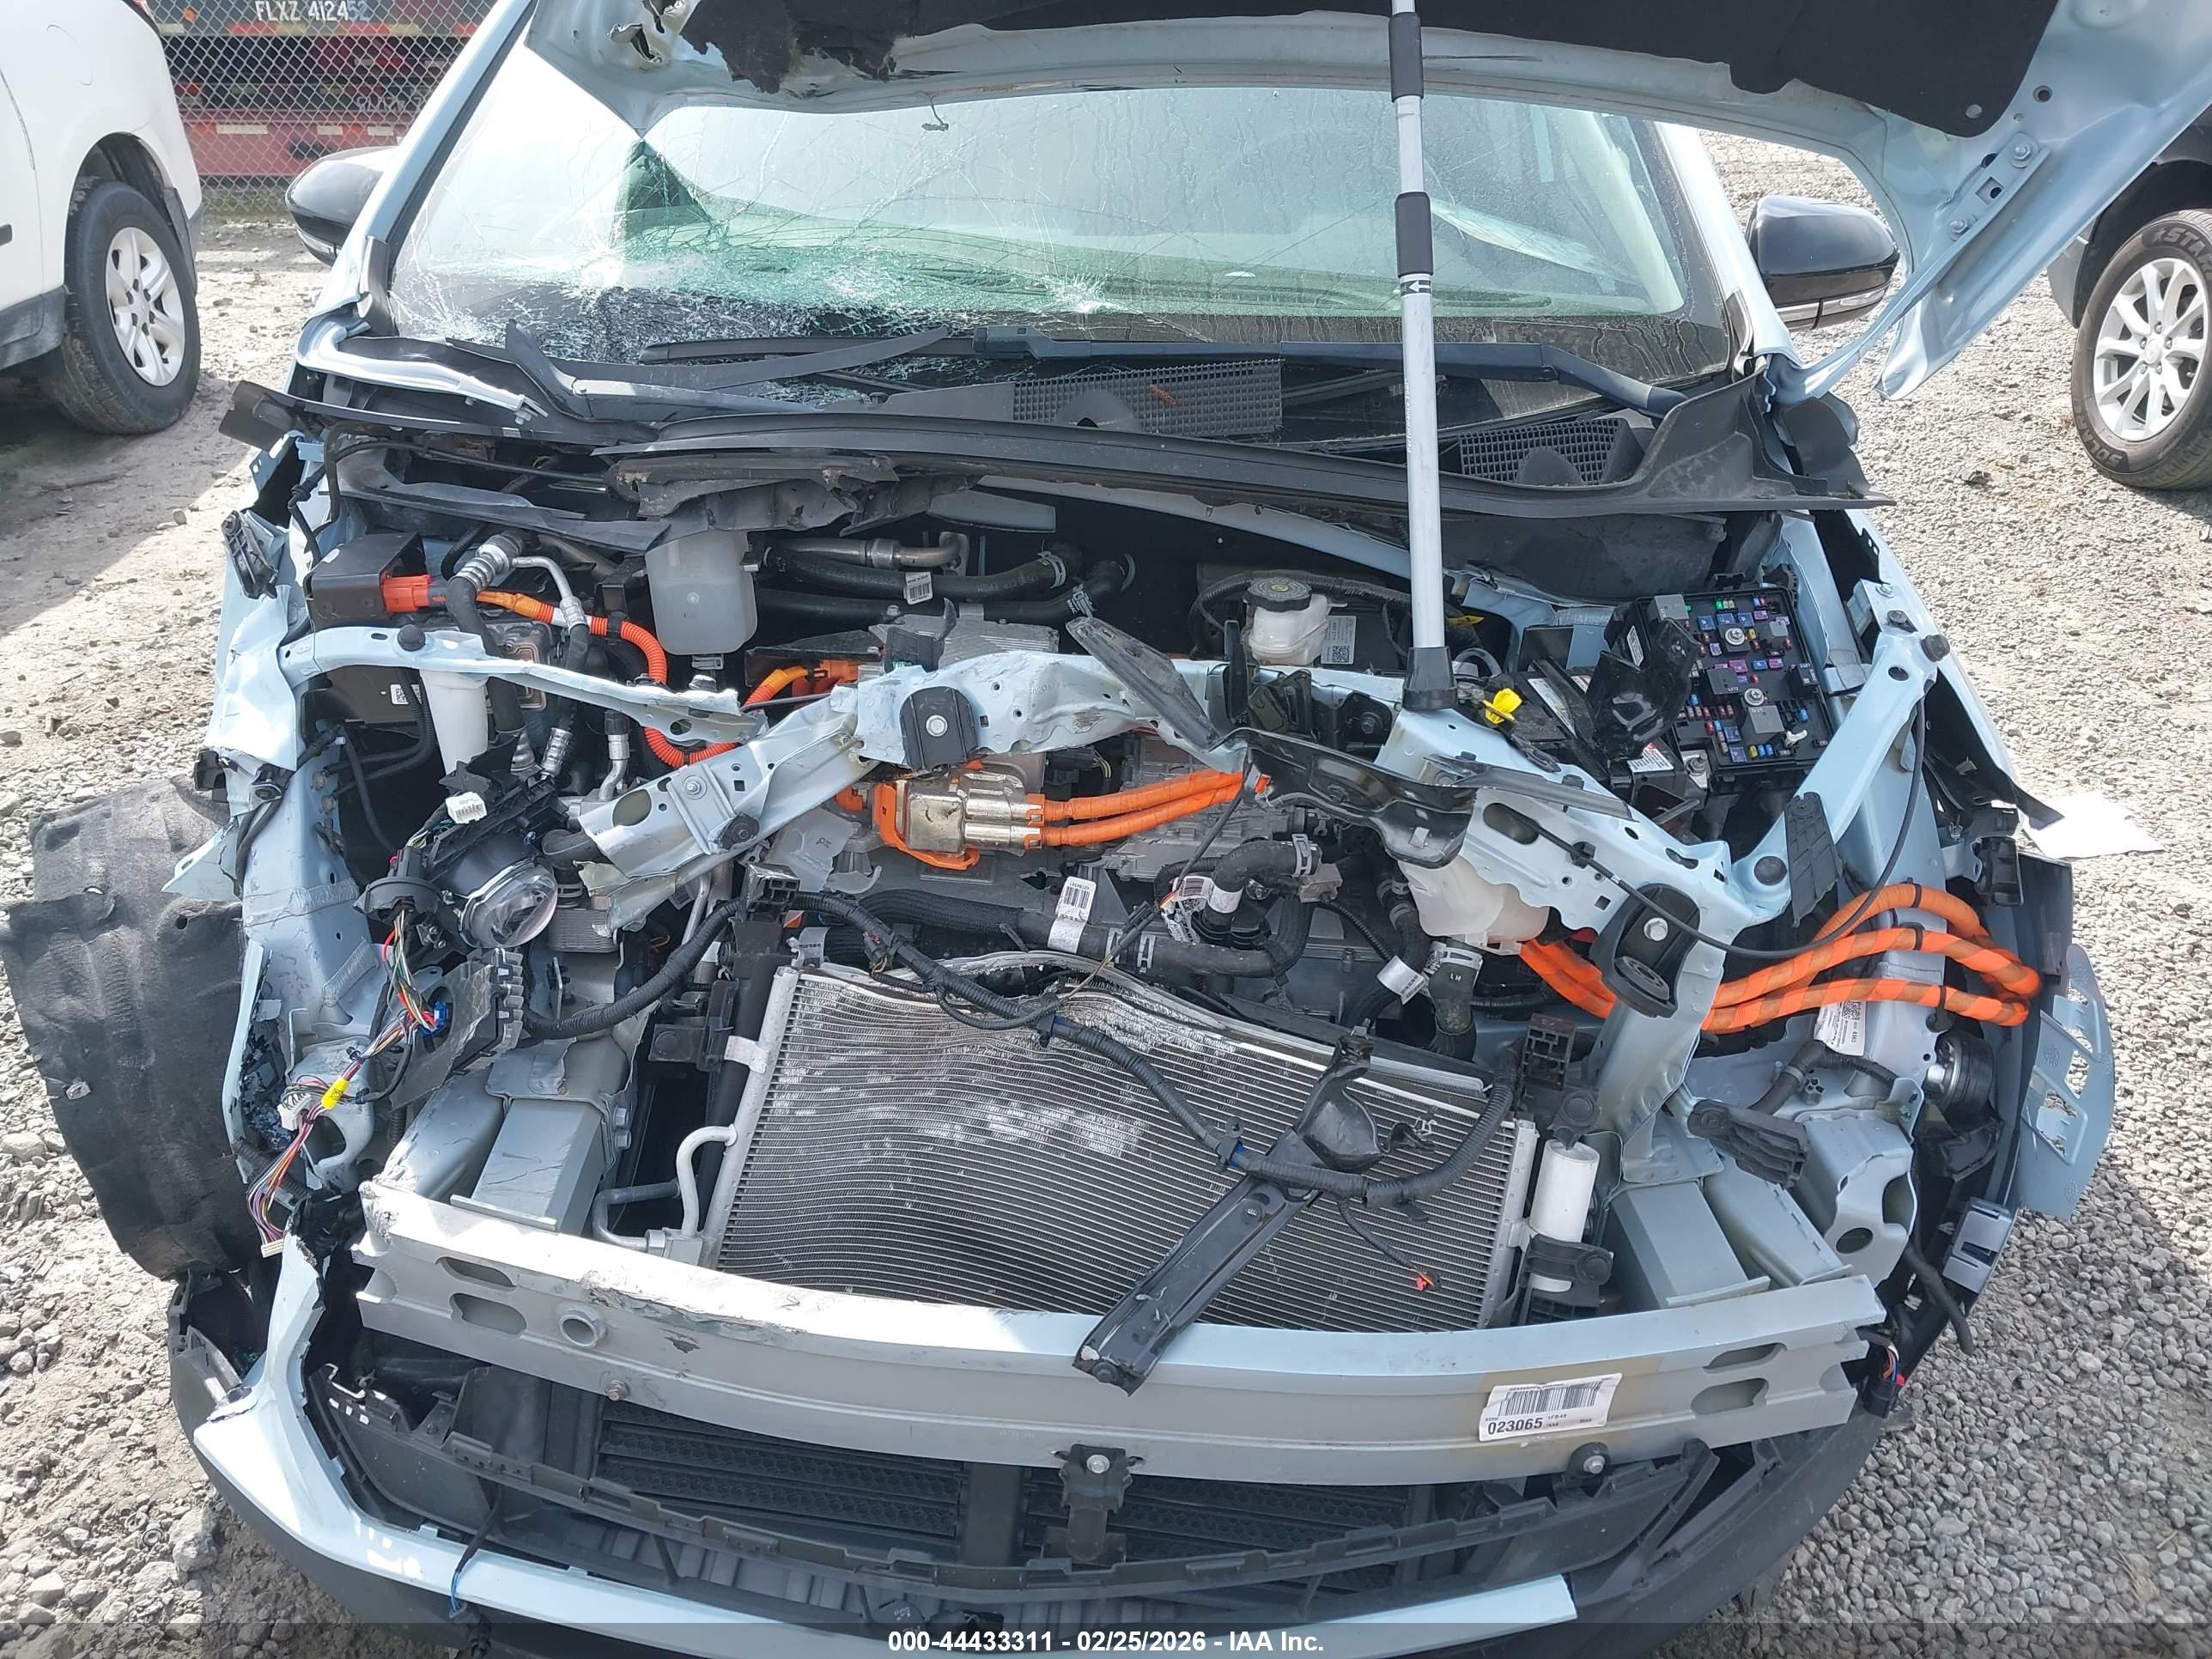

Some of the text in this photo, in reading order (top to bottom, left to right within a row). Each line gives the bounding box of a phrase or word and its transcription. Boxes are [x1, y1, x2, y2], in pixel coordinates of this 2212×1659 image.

[255, 0, 371, 21] FLXZ 412452
[1487, 1417, 1544, 1435] 023065
